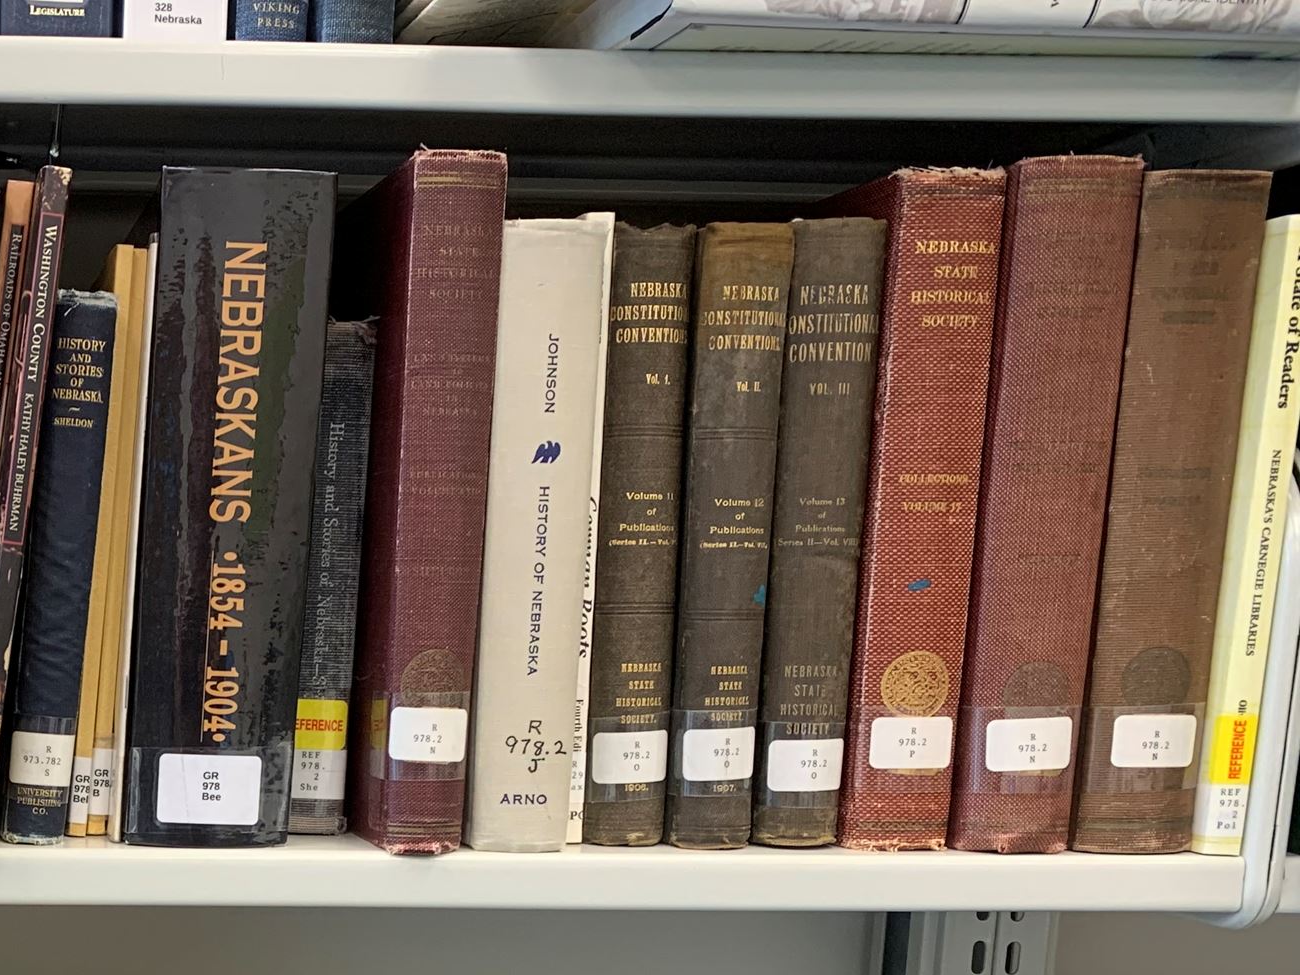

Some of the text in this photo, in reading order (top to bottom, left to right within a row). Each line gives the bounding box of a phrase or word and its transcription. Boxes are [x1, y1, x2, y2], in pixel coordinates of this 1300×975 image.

[29, 5, 86, 17] LEGISLATURE
[154, 2, 173, 12] 328
[154, 14, 202, 25] Nebraska
[257, 17, 296, 29] PRESS
[915, 240, 997, 255] NEBRASKA
[934, 265, 979, 280] STATE
[630, 281, 688, 299] NEBRASKA
[910, 289, 992, 305] HISTORICAL
[921, 313, 979, 328] SOCIETY
[56, 337, 107, 353] HISTORY
[69, 353, 92, 364] AND
[789, 342, 872, 363] CONVENTION
[1278, 318, 1300, 410] of Readers
[54, 363, 105, 378] STORIES
[9, 225, 58, 532] WASHINGTON COUNTY KATHY HALEY BUHRMAN
[208, 241, 268, 523] NEBRASKANS
[51, 388, 104, 403] NEBRASKA
[53, 416, 94, 428] SHELDON
[527, 334, 560, 677] JOHNSON HISTORY OF NEBRASKA
[709, 525, 765, 535] Publications
[710, 665, 749, 676] NEBRASKA
[784, 664, 838, 678] NEBRASKA
[628, 680, 655, 690] STATE
[718, 681, 742, 690] STATE
[413, 734, 442, 743] 978.2
[897, 738, 928, 748] 978.2
[504, 735, 568, 757] 978.2
[1018, 743, 1048, 753] 978.2
[1141, 740, 1171, 750] 978.2
[1228, 720, 1247, 780] REFERENCE
[301, 751, 321, 759] REF
[623, 750, 651, 760] 978.2
[713, 747, 740, 757] 978.2
[22, 755, 62, 766] 973.782
[301, 762, 325, 770] 978.
[800, 758, 828, 769] 978.2
[300, 782, 319, 790] She
[1220, 788, 1241, 796] REF
[499, 793, 548, 806] ARNO
